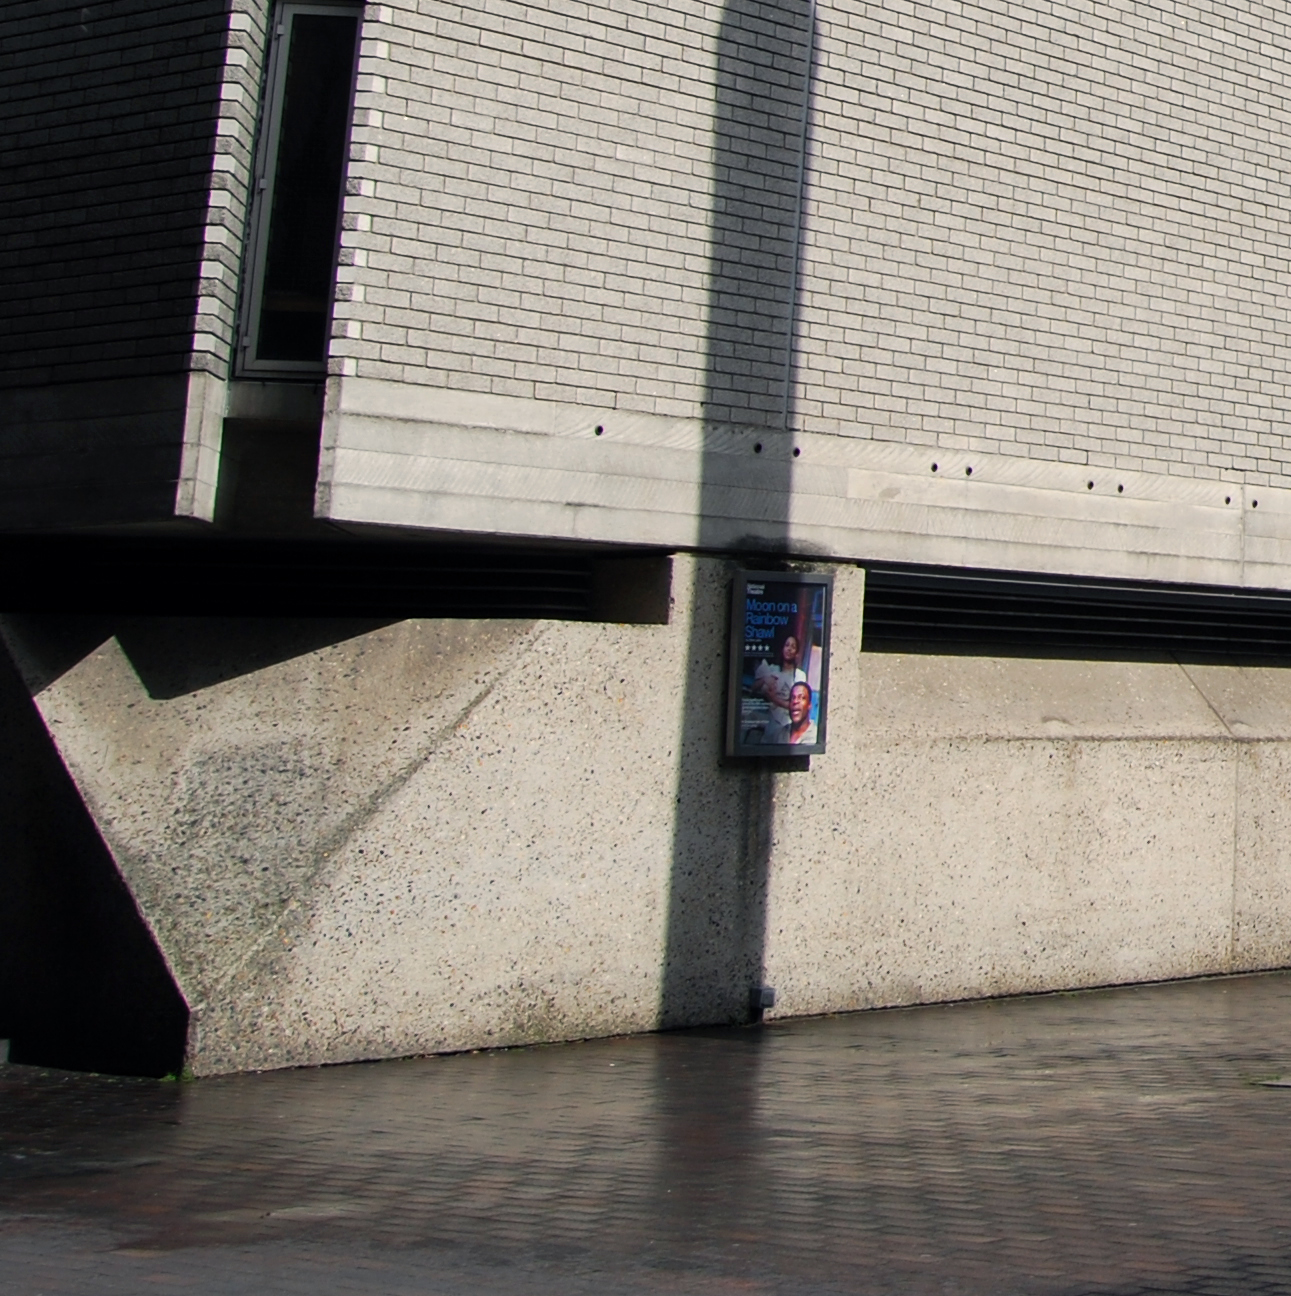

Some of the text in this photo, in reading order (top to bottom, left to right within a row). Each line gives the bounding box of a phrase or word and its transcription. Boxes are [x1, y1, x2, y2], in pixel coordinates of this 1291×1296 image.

[746, 598, 798, 613] Moon on a
[745, 611, 789, 625] Rainbow
[745, 625, 775, 639] Shawl
